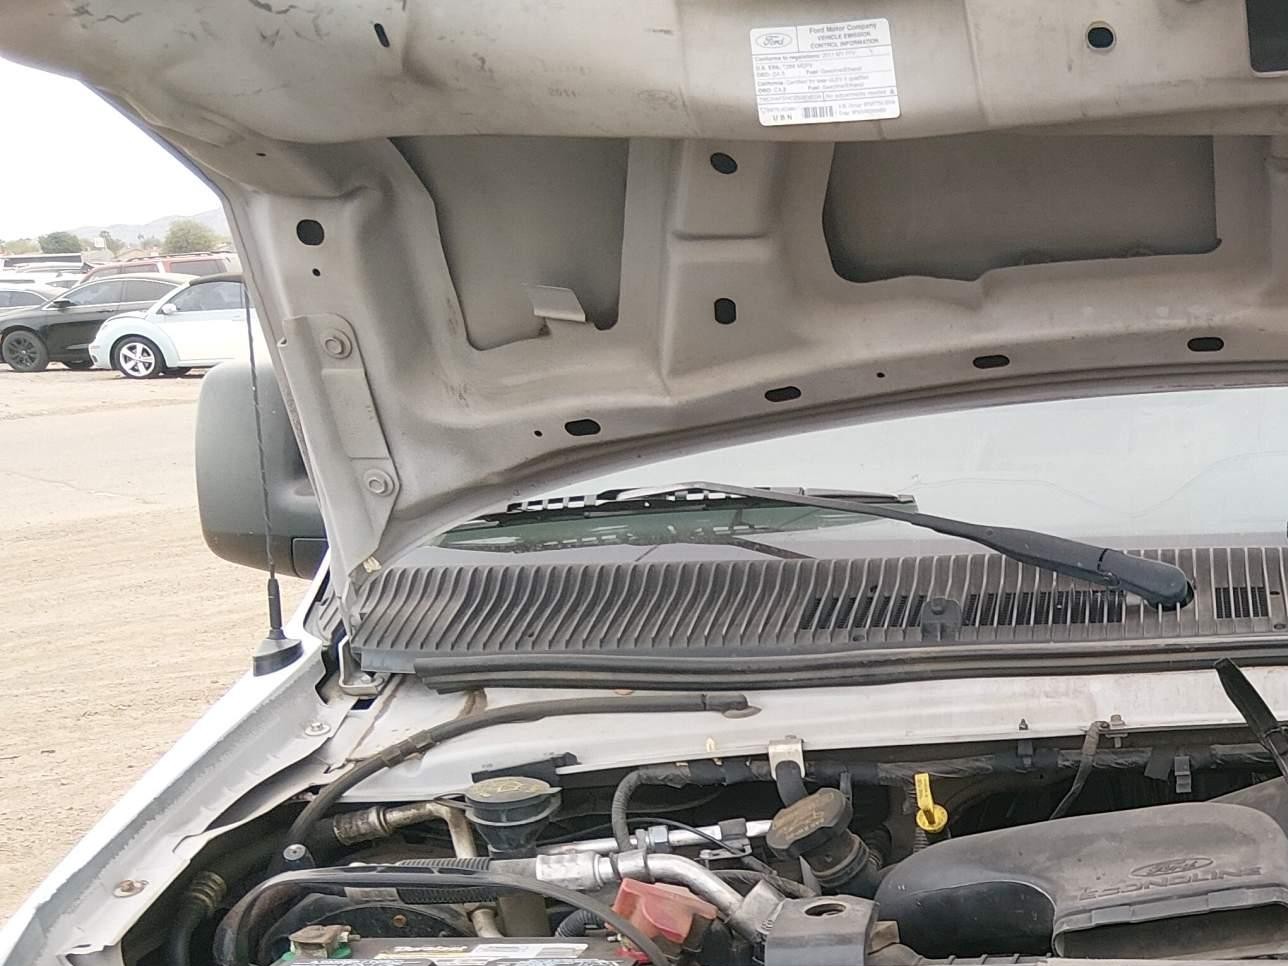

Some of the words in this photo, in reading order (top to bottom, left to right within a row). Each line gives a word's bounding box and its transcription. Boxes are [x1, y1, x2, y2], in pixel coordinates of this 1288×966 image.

[809, 26, 825, 34] Ford
[826, 24, 846, 33] Motor
[847, 22, 877, 31] Company
[817, 33, 842, 41] VEHICLE
[844, 31, 871, 39] EMISSION
[810, 41, 838, 49] CONTROL
[840, 38, 879, 47] INFORMATION
[1080, 866, 1263, 901] ECONOLINE
